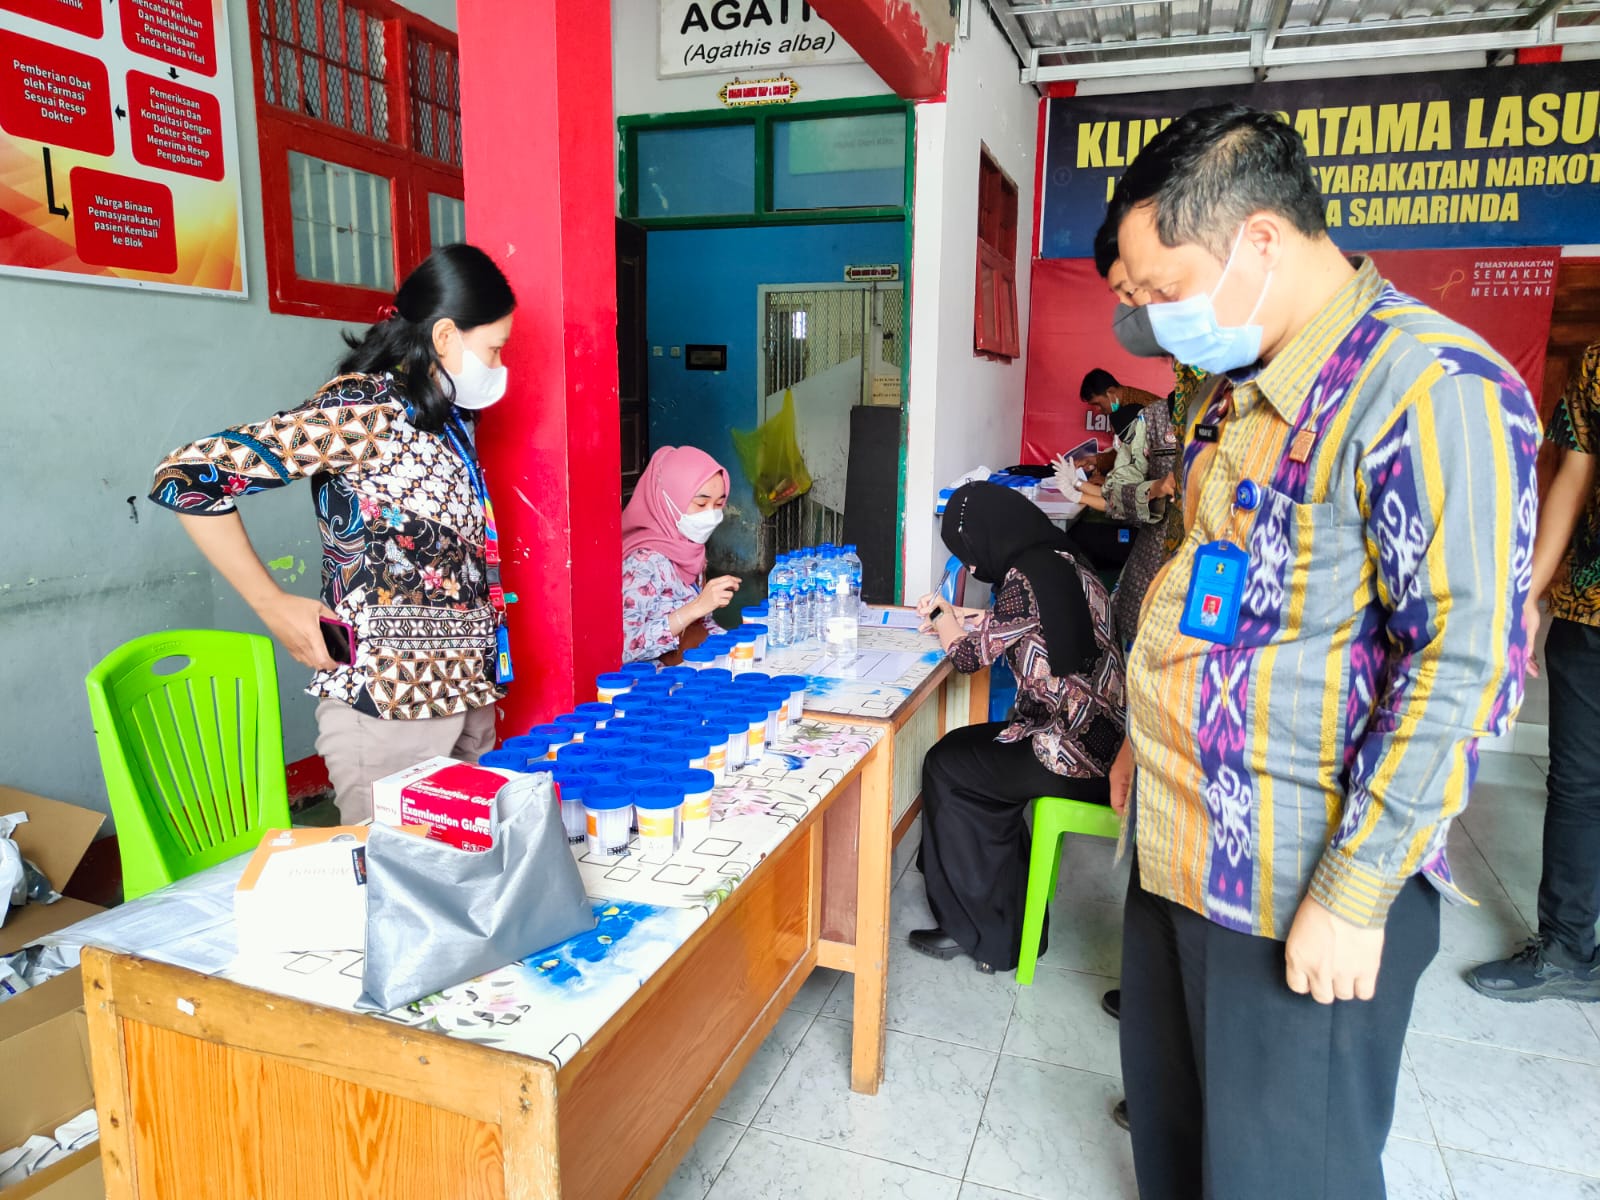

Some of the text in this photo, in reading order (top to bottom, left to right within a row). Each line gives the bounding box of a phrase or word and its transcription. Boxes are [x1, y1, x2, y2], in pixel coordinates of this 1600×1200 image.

[138, 9, 199, 38] Dan Melakukan
[170, 9, 203, 29] Keluhan
[135, 32, 205, 64] Tanda-tanda Vital
[144, 23, 195, 49] Pemeriksaan
[683, 31, 835, 66] (Agathis alba)
[13, 59, 91, 91] Pemberian Obat
[23, 77, 85, 102] oleh Farmasi
[149, 86, 200, 109] Pemeriksaan
[24, 89, 87, 117] Sesuai Resep
[41, 107, 74, 124] Dokter
[150, 98, 202, 121] Lanjutan Dan
[140, 108, 212, 135] Konsultasi Dengan
[153, 124, 202, 144] Dokter Serta
[1076, 90, 1600, 169] KLIN ATAMA LASU
[146, 134, 210, 159] Menerima Resep
[156, 148, 203, 167] Pengobatan
[1311, 159, 1479, 195] YARAKATAN
[94, 194, 153, 214] Warga Binaan
[1348, 192, 1519, 227] SAMARINDA
[94, 221, 158, 239] pasien Kembali
[112, 234, 144, 248] ke Blok
[1473, 268, 1553, 280] SEMAKIN
[1474, 260, 1554, 269] PEMASYARAKATAN
[1471, 286, 1550, 297] MELAYANI
[402, 803, 459, 828] Examination
[461, 818, 492, 836] Glove
